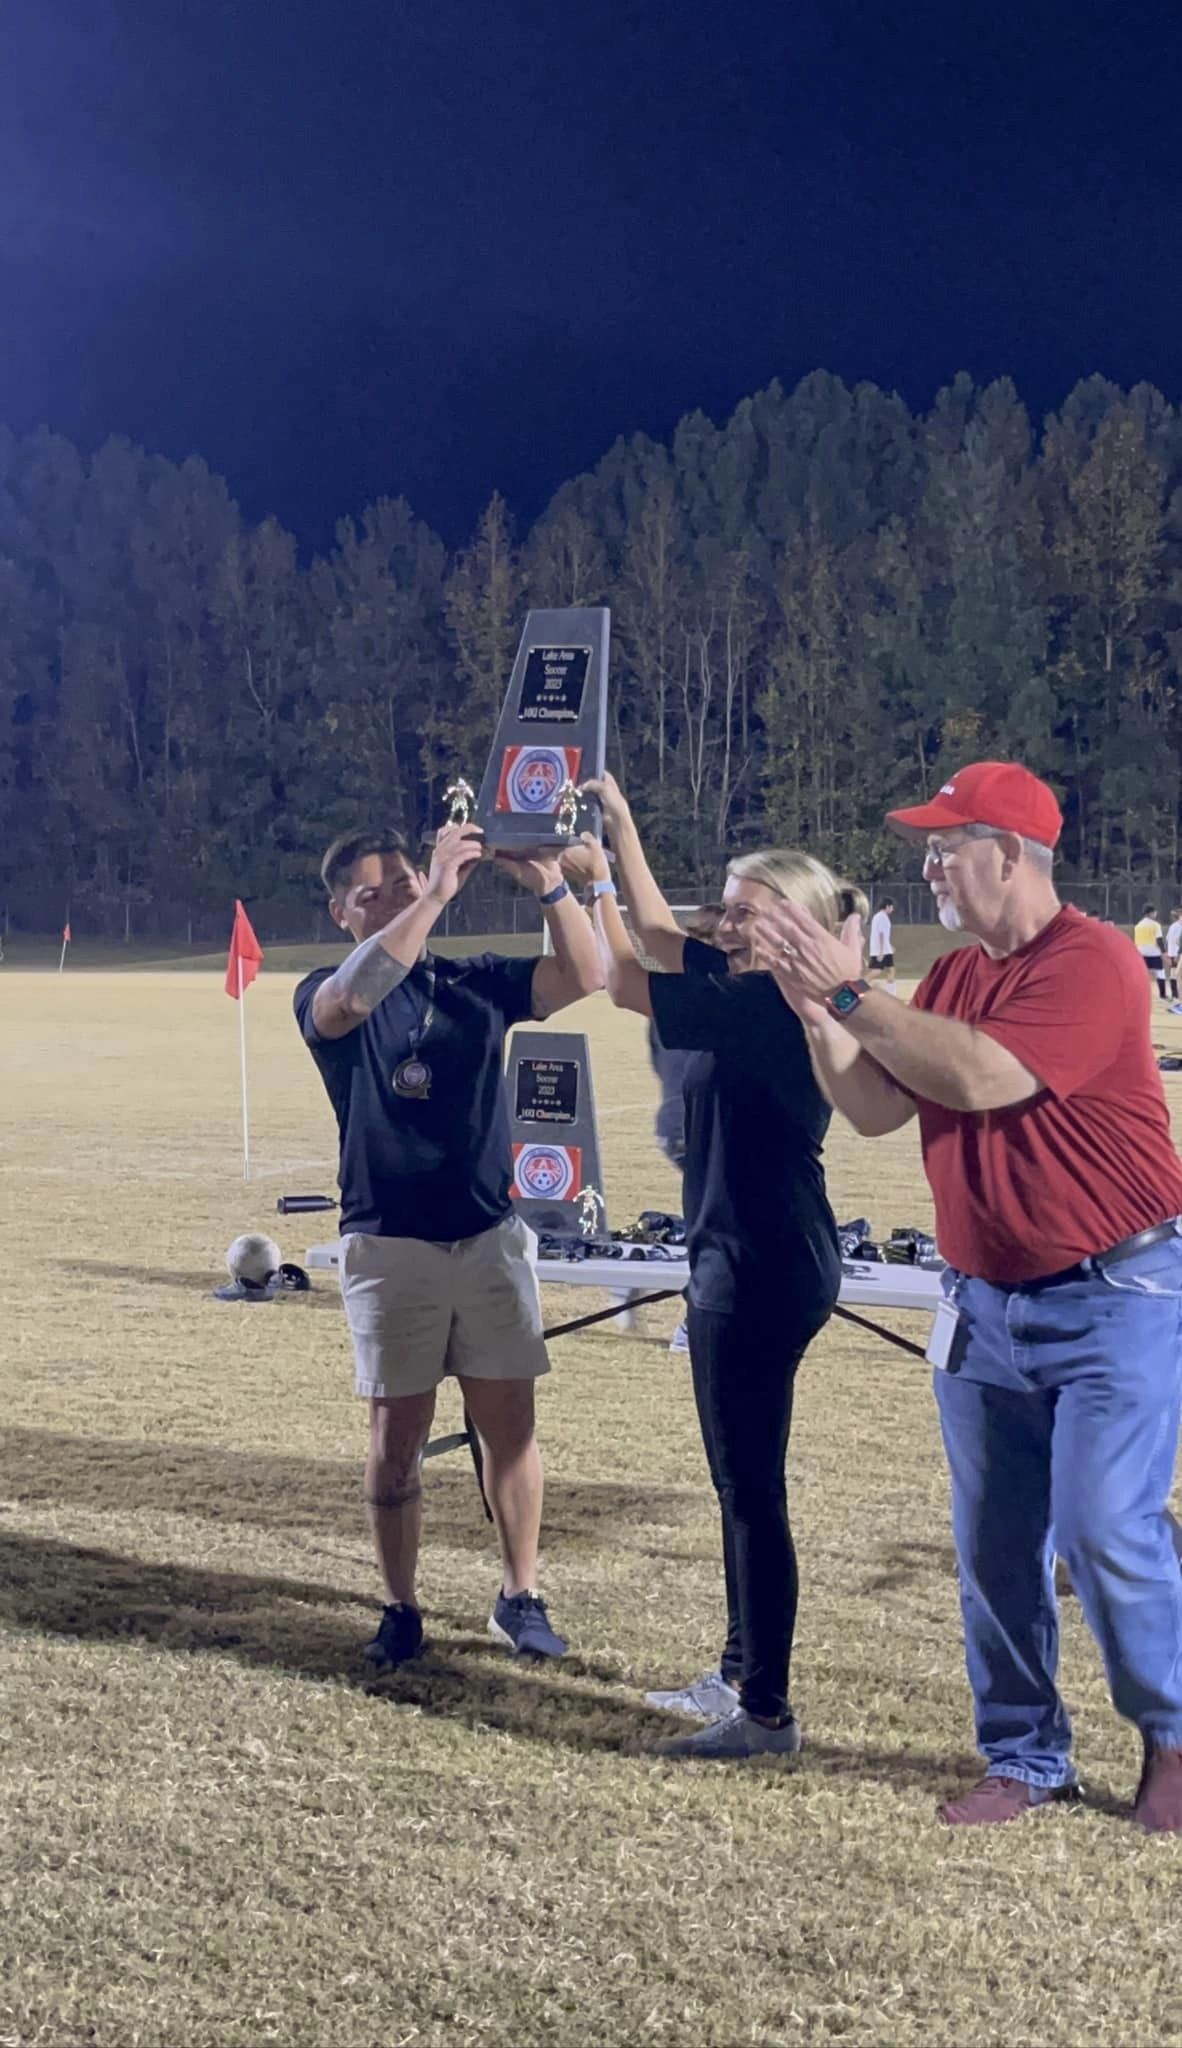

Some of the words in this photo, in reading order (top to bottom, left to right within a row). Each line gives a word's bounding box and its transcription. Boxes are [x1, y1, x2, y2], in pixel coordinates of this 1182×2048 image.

[542, 650, 558, 661] Lake
[559, 650, 575, 661] Area
[544, 664, 568, 675] Soccer
[532, 1062, 547, 1072] Lake
[549, 1063, 564, 1073] Area
[536, 1073, 558, 1084] Soccer
